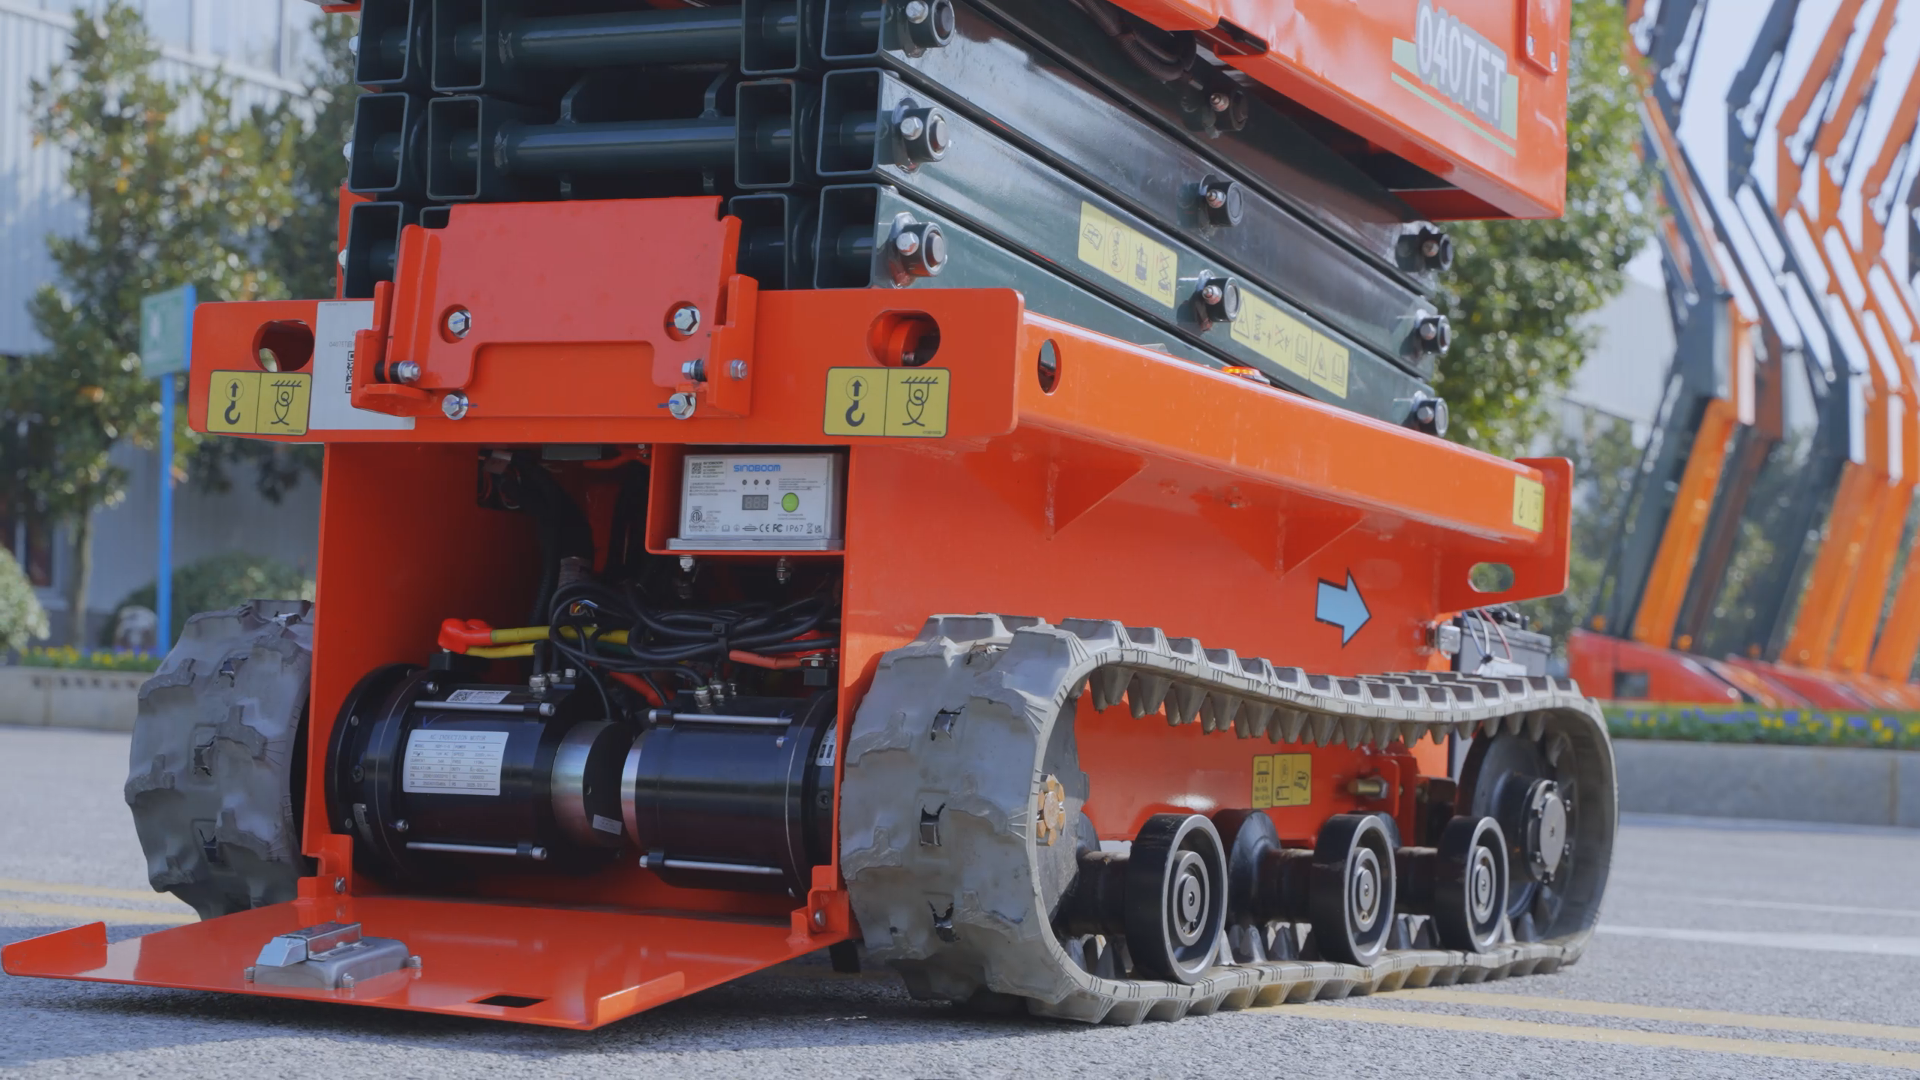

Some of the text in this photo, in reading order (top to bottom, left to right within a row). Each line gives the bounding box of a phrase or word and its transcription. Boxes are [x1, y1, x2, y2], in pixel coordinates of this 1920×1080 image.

[1418, 4, 1506, 122] 0407ET
[733, 464, 781, 473] SINOBOOM
[786, 524, 804, 533] IP67
